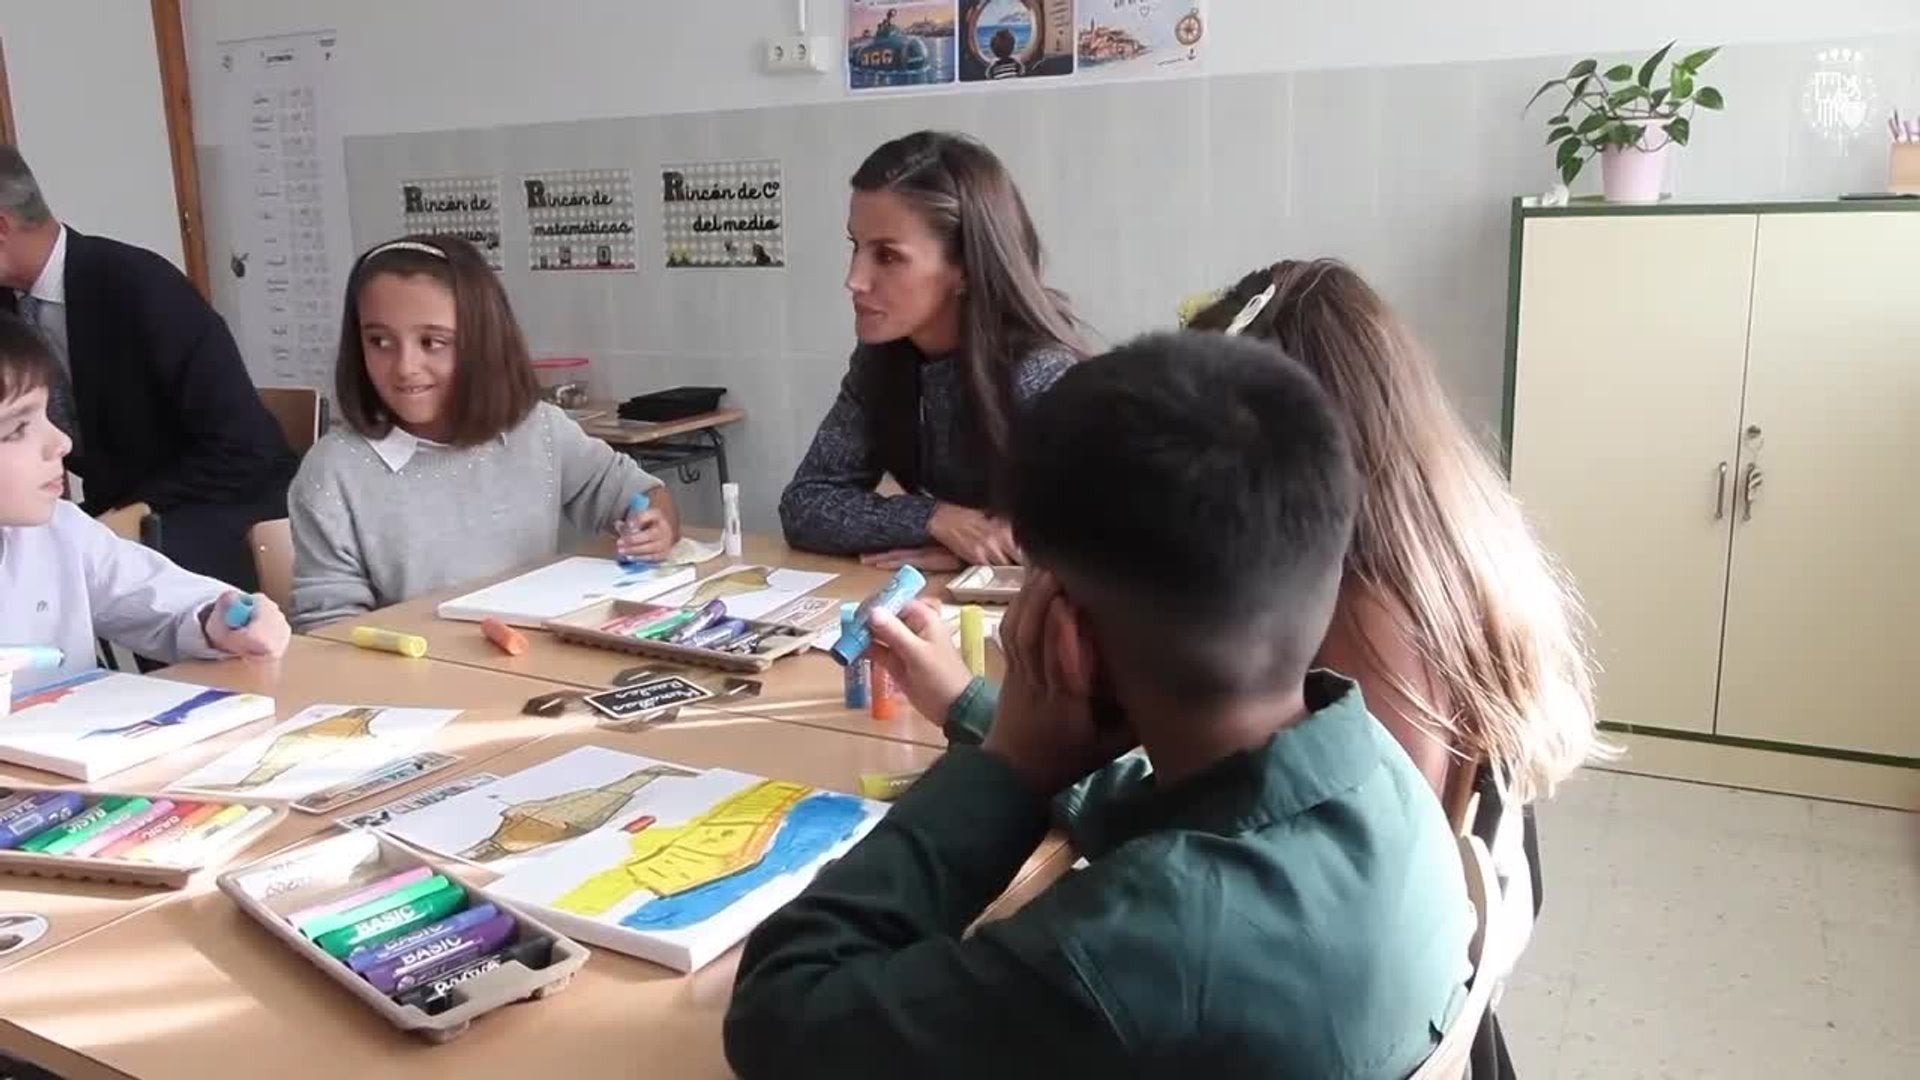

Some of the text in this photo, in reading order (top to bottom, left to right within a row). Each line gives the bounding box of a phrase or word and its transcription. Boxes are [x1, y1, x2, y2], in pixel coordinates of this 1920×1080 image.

[403, 186, 492, 213] Rincón de
[524, 180, 614, 208] Rincón de
[662, 171, 735, 201] Rincón
[738, 181, 761, 199] de
[534, 220, 633, 236] matemáticas
[692, 213, 780, 232] del medio
[354, 904, 416, 937] BASIC
[401, 935, 462, 966] BASIC
